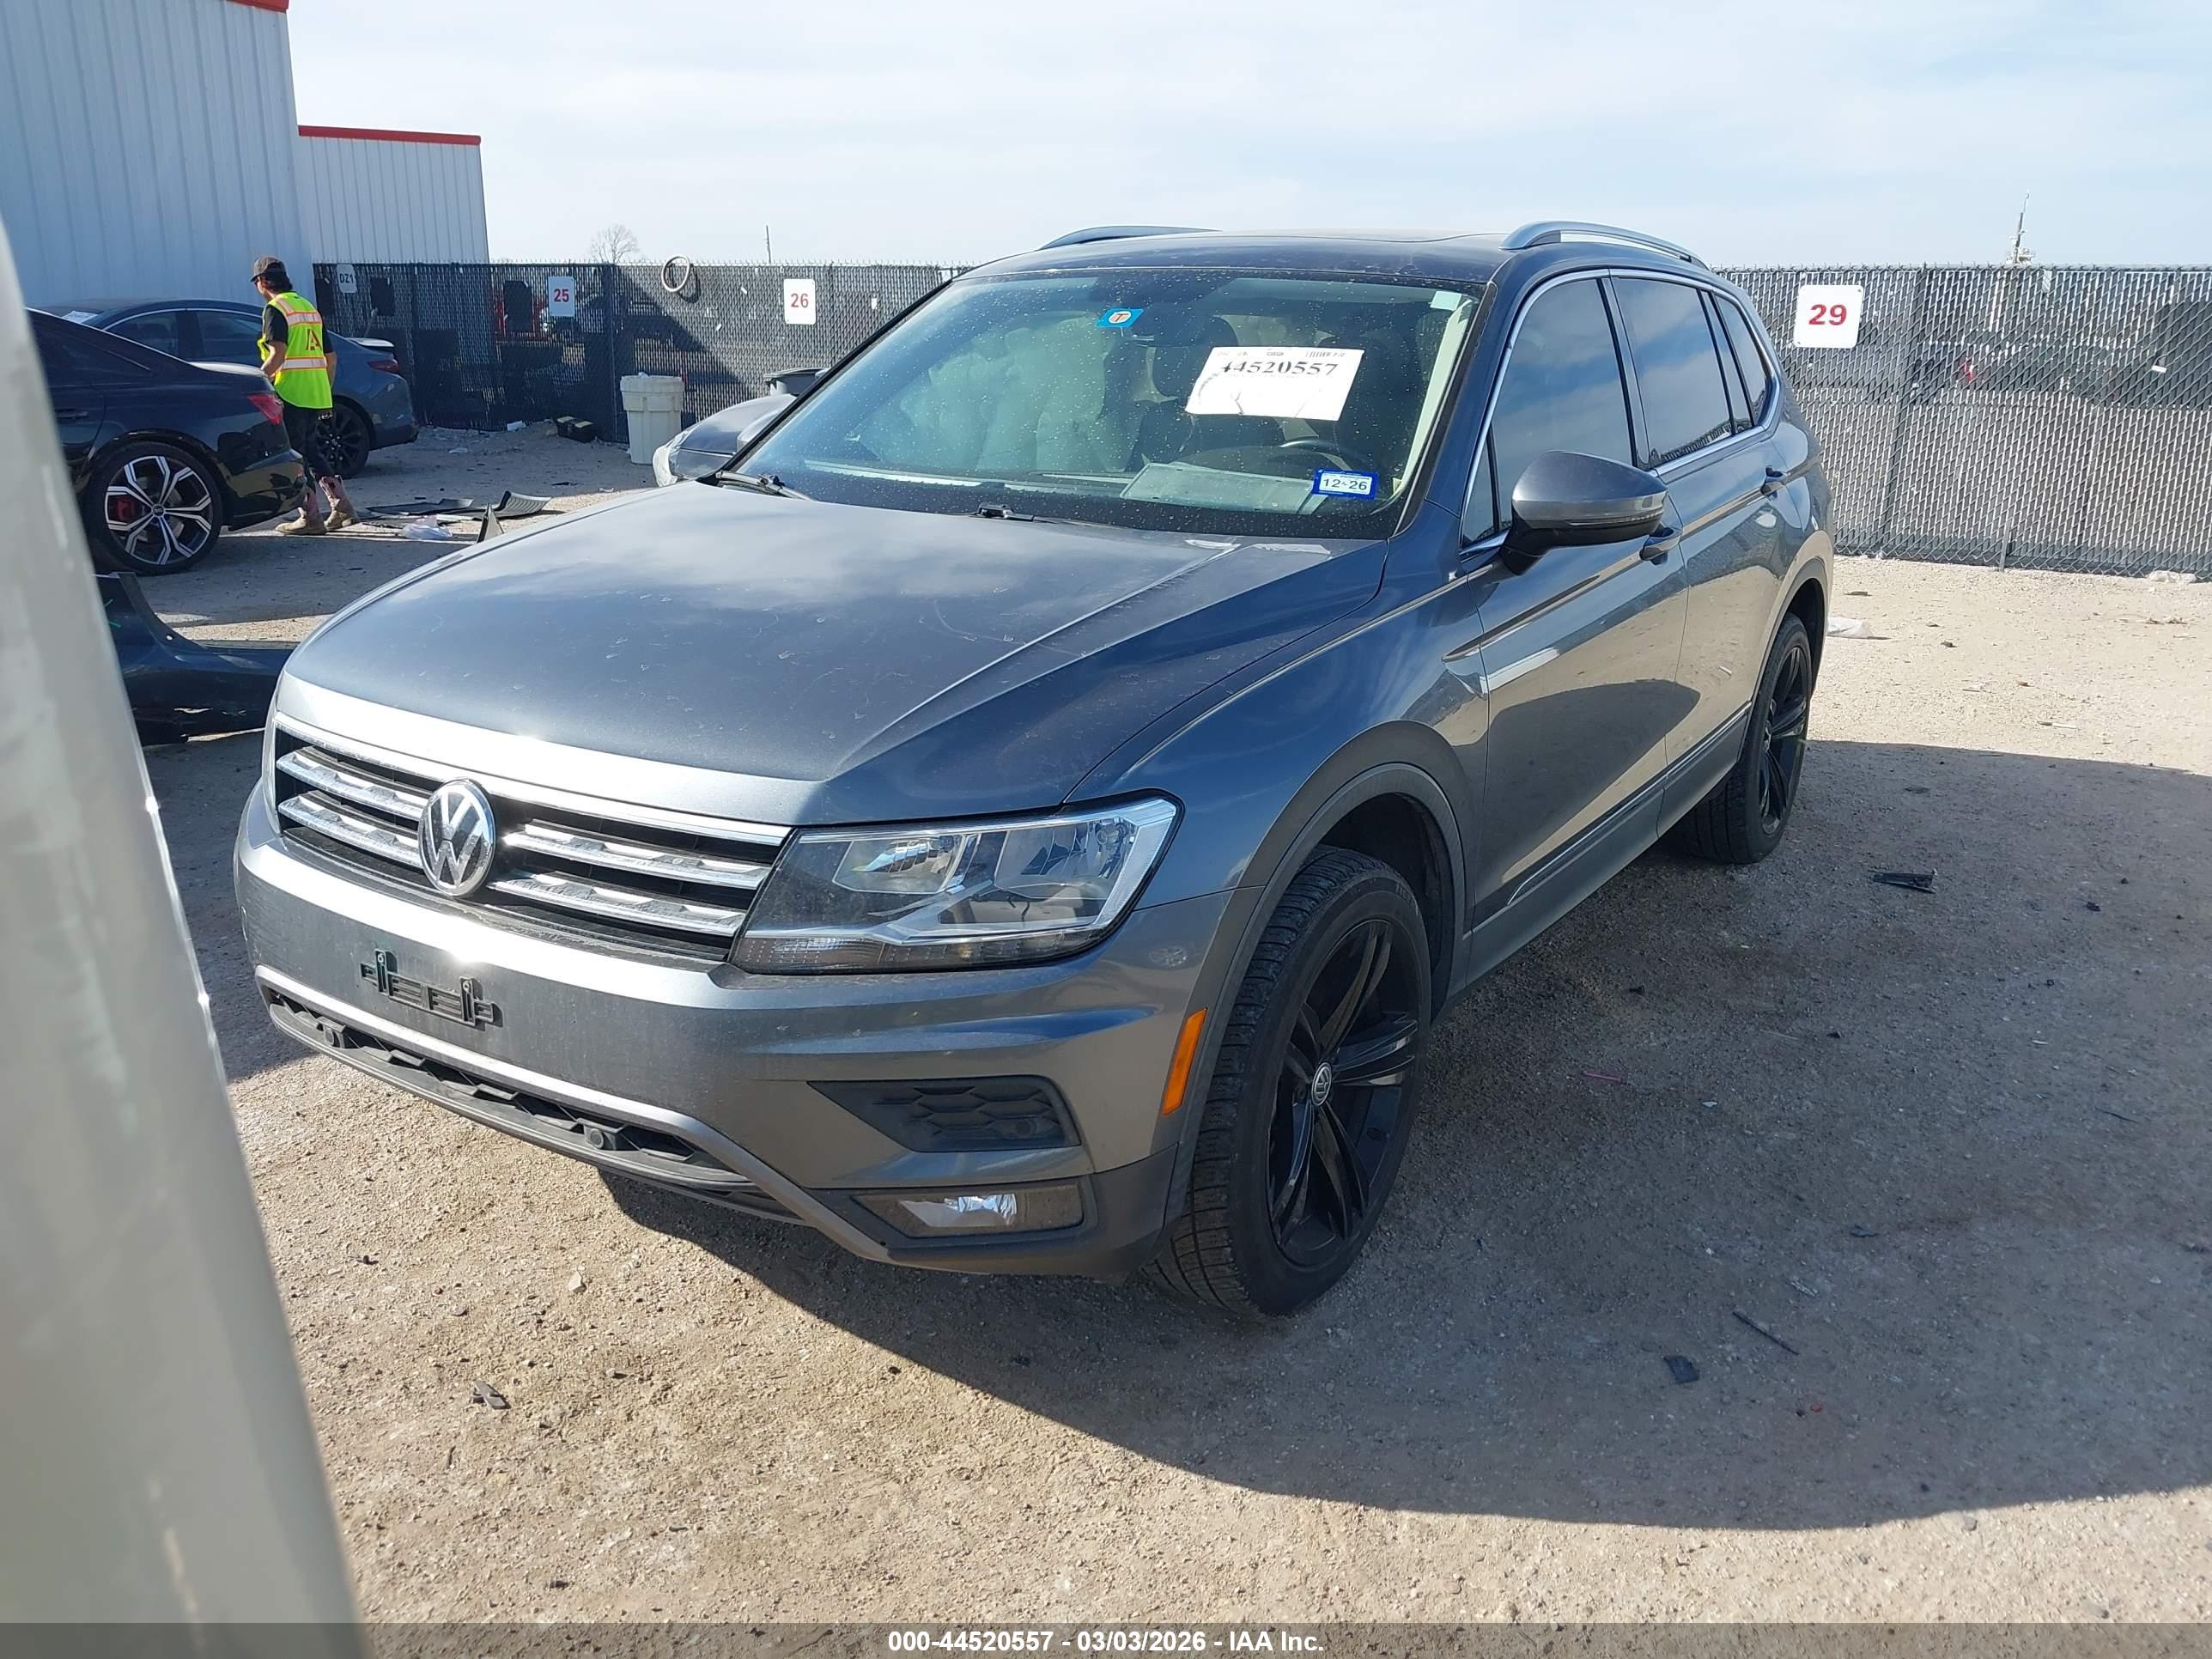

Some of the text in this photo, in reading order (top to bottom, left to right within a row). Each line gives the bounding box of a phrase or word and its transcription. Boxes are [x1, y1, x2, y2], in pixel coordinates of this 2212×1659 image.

[554, 289, 569, 302] 25
[791, 293, 809, 308] 26
[1808, 304, 1847, 325] 29
[1222, 360, 1340, 376] 44520557
